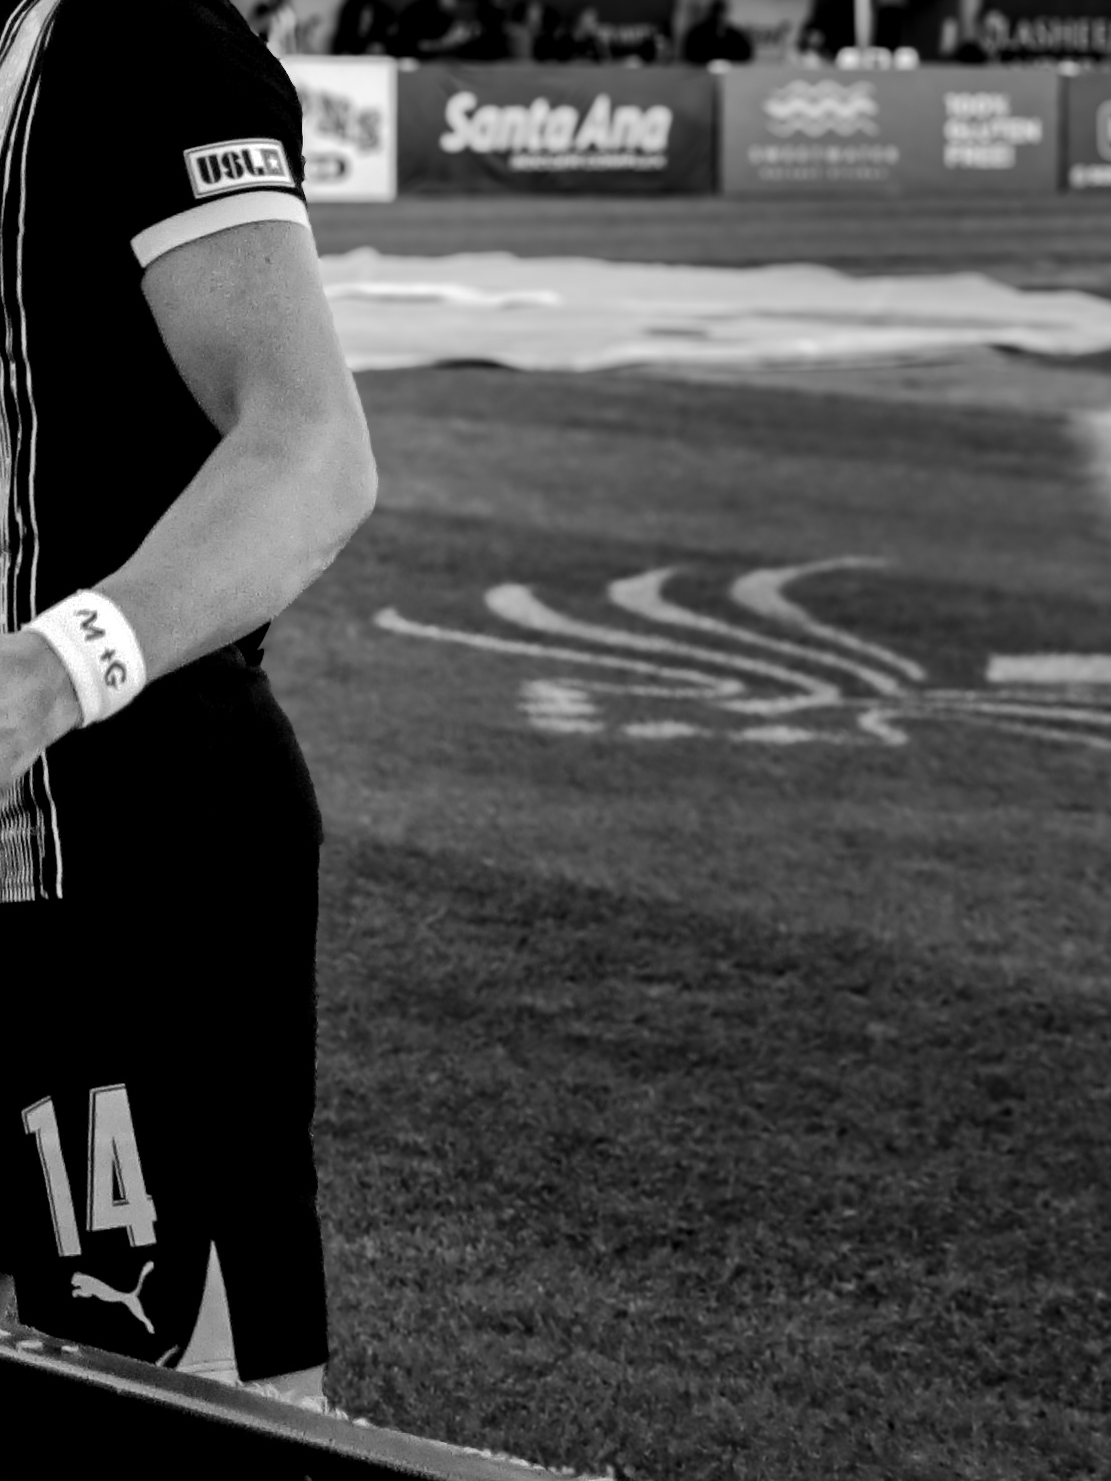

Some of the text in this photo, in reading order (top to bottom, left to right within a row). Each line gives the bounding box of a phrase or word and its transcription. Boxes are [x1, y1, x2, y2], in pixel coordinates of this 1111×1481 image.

[439, 91, 580, 153] Santa
[574, 93, 674, 154] Ana
[21, 1083, 157, 1257] 14
